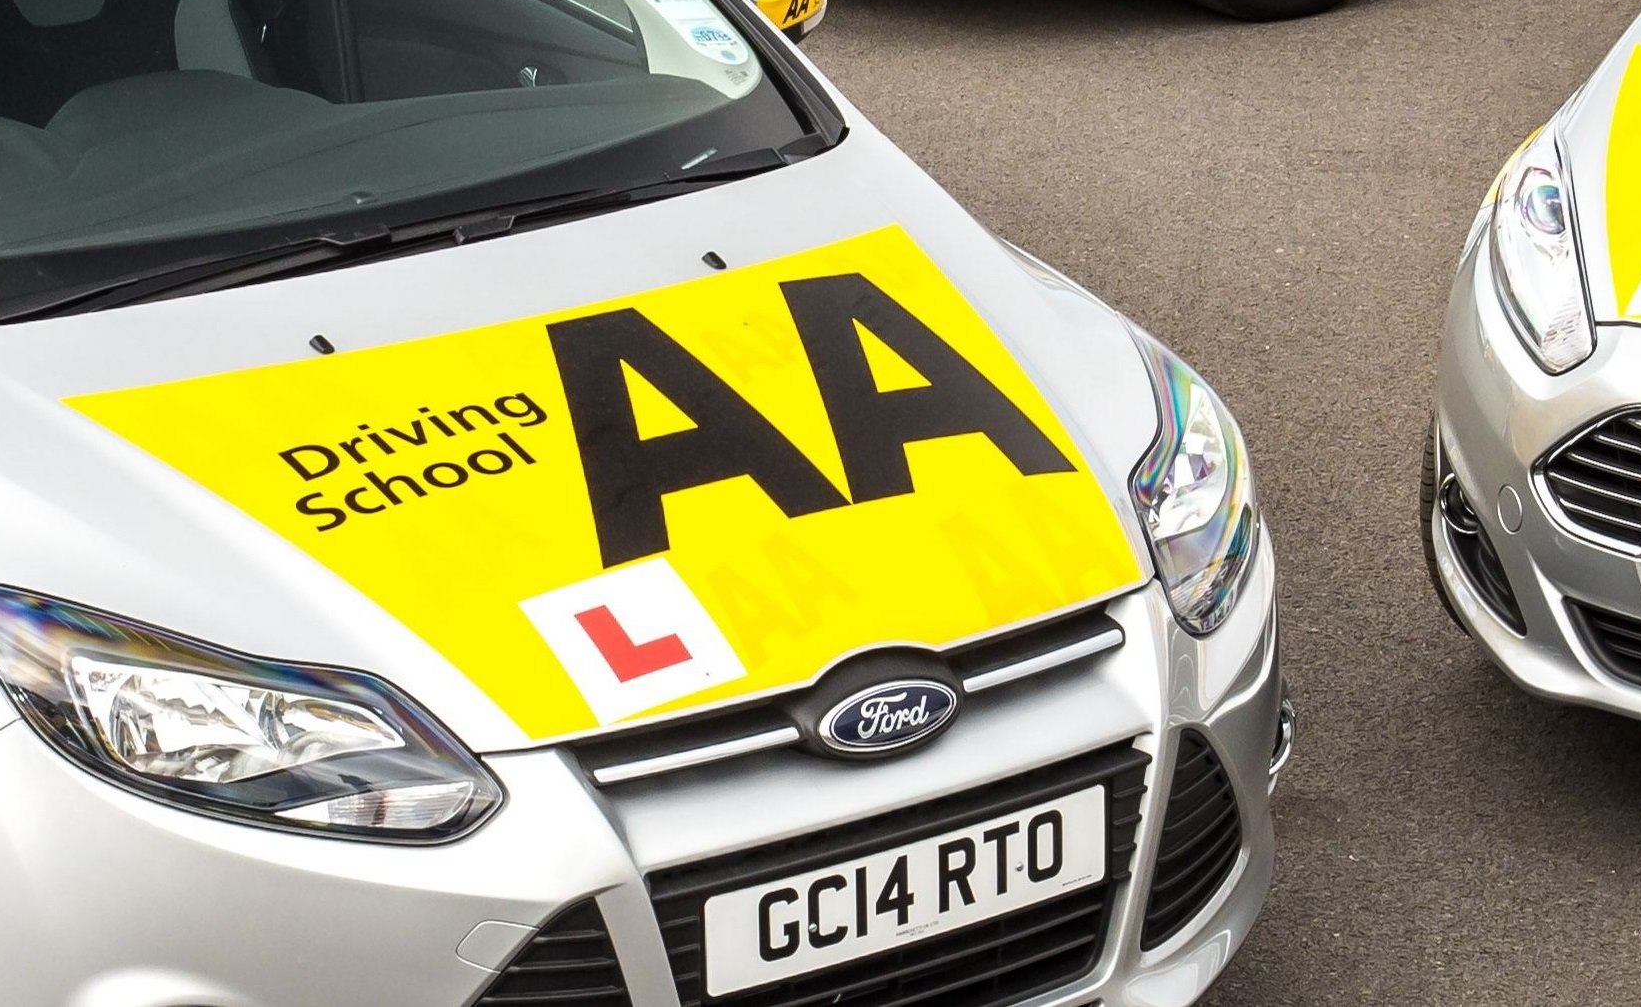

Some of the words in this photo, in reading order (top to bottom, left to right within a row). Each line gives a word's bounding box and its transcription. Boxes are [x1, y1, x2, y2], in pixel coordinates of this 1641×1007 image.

[276, 391, 548, 483] Driving
[544, 271, 1079, 571] AA
[294, 431, 538, 533] School
[573, 605, 694, 686] L
[857, 690, 930, 739] Ford
[757, 854, 915, 963] GC14
[937, 808, 1064, 914] RTO
